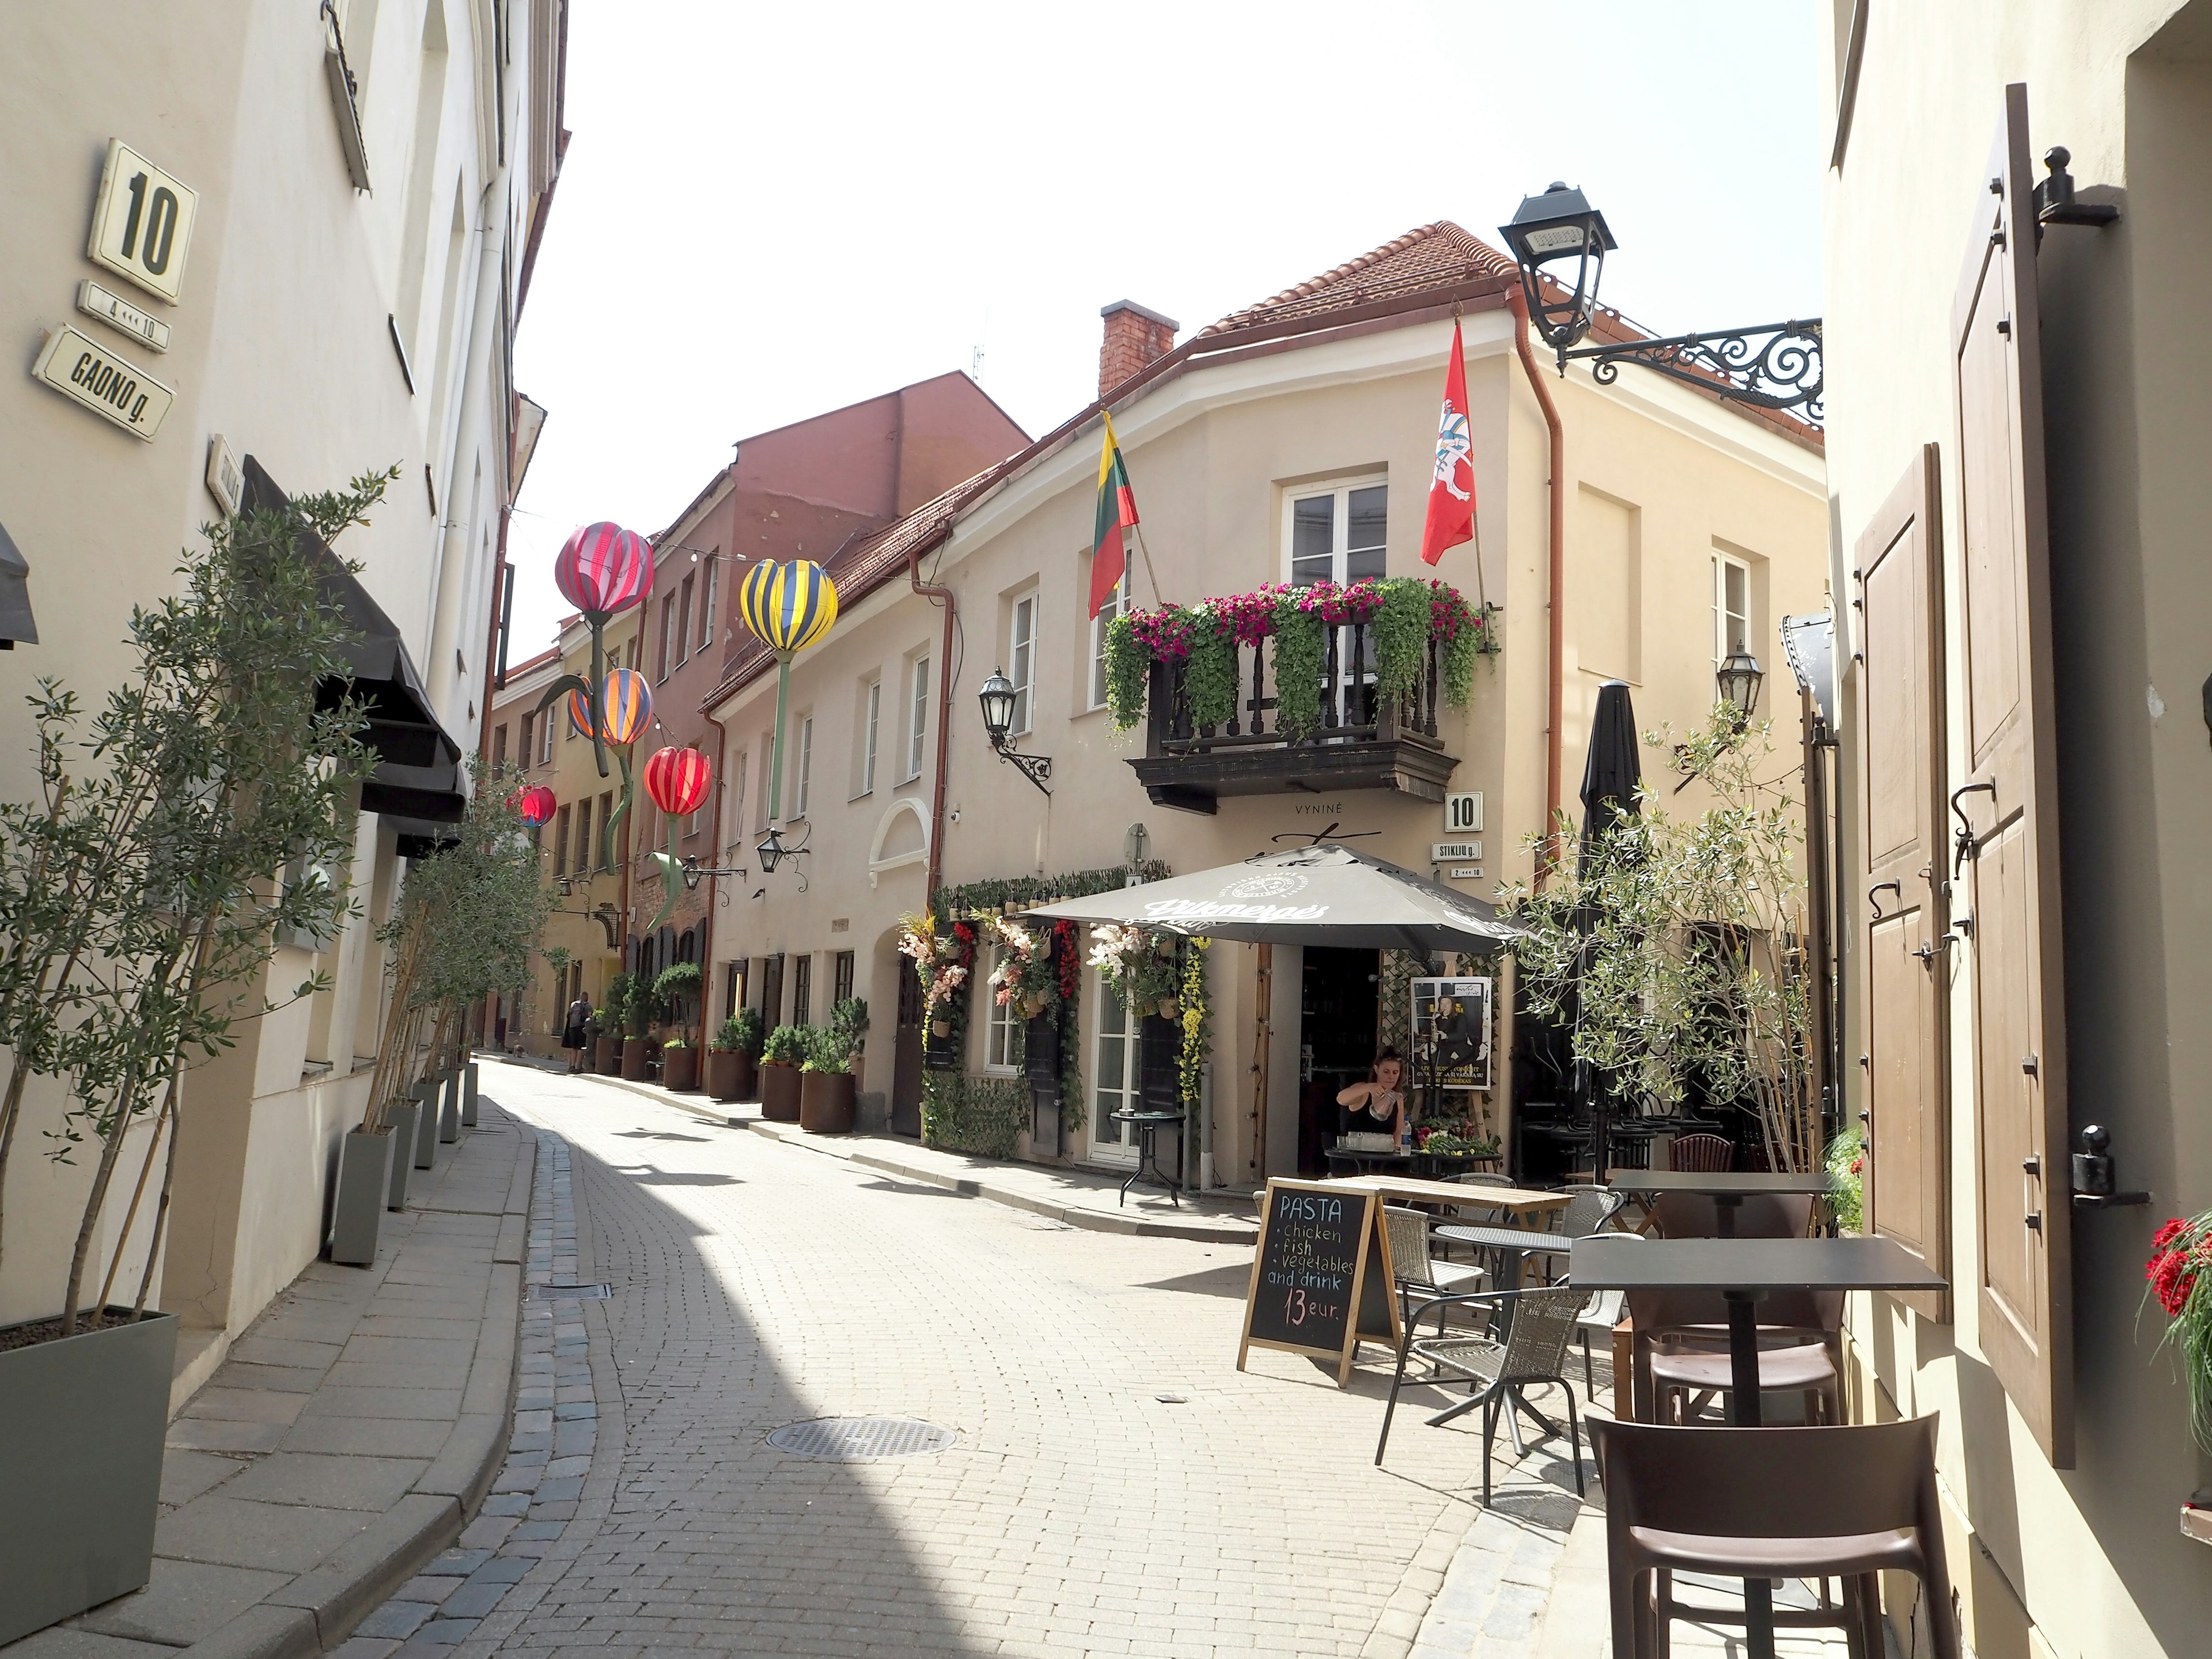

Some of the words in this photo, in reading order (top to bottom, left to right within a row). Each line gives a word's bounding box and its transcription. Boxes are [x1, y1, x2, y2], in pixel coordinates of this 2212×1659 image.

[121, 171, 179, 275] 10
[110, 300, 118, 317] 4
[143, 319, 155, 338] 10
[71, 352, 137, 410] GAONO
[128, 394, 149, 423] g.
[1296, 802, 1342, 815] VYNINĖ
[1452, 797, 1474, 827] 10
[1468, 847, 1475, 857] g.
[1279, 1195, 1342, 1224] PASTA
[1284, 1222, 1342, 1243] chicken
[1283, 1238, 1312, 1256] fish
[1282, 1255, 1354, 1275] vegetables
[1268, 1270, 1294, 1287] and
[1300, 1271, 1342, 1291] drink
[1283, 1287, 1306, 1326] 13
[1308, 1302, 1339, 1320] eur.
